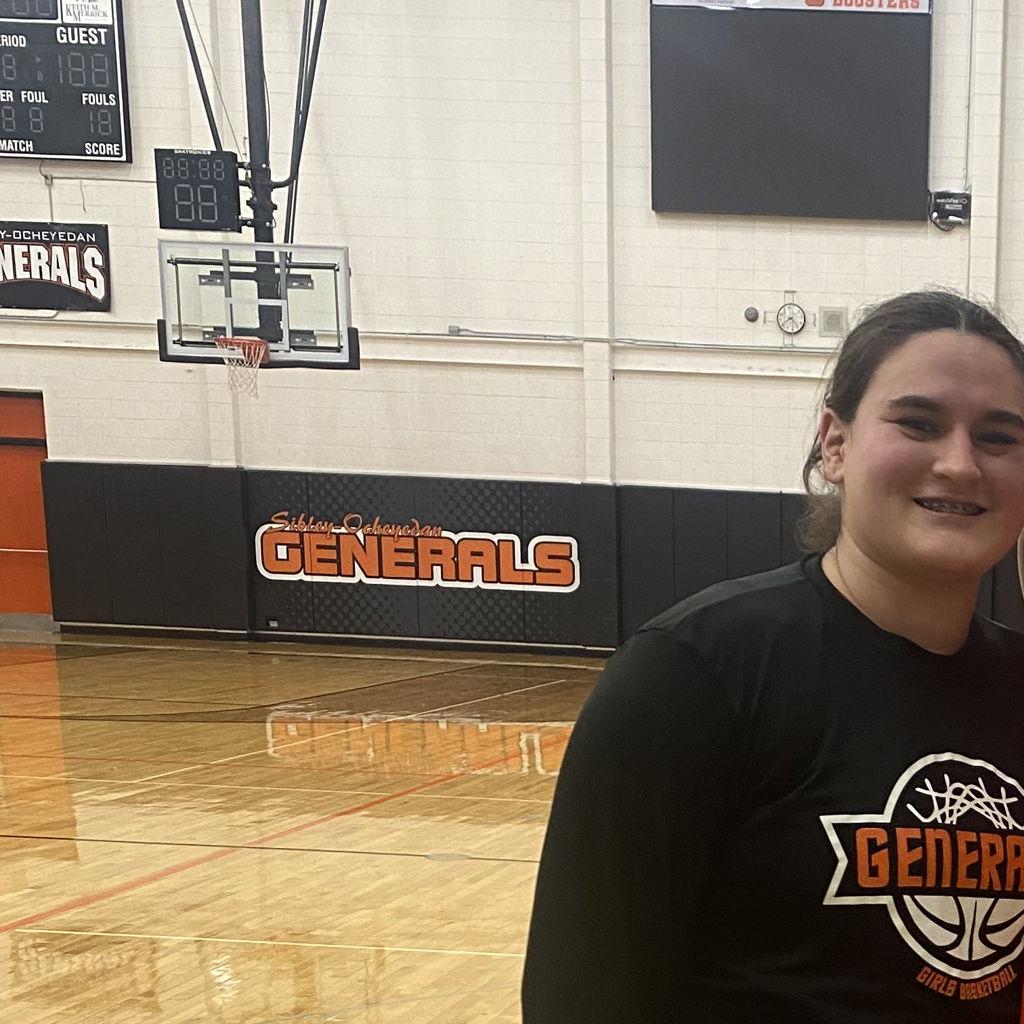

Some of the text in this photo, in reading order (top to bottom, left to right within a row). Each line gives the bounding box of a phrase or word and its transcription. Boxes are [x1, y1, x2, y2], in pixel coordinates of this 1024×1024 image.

[0, 34, 26, 47] RIOD
[56, 27, 107, 45] GUEST
[21, 90, 49, 103] FOUL
[82, 93, 116, 106] FOULS
[0, 139, 33, 152] MATCH
[85, 143, 120, 156] SCORE
[0, 230, 96, 242] Y-OCHEYEDAN
[261, 529, 577, 588] GENERALS
